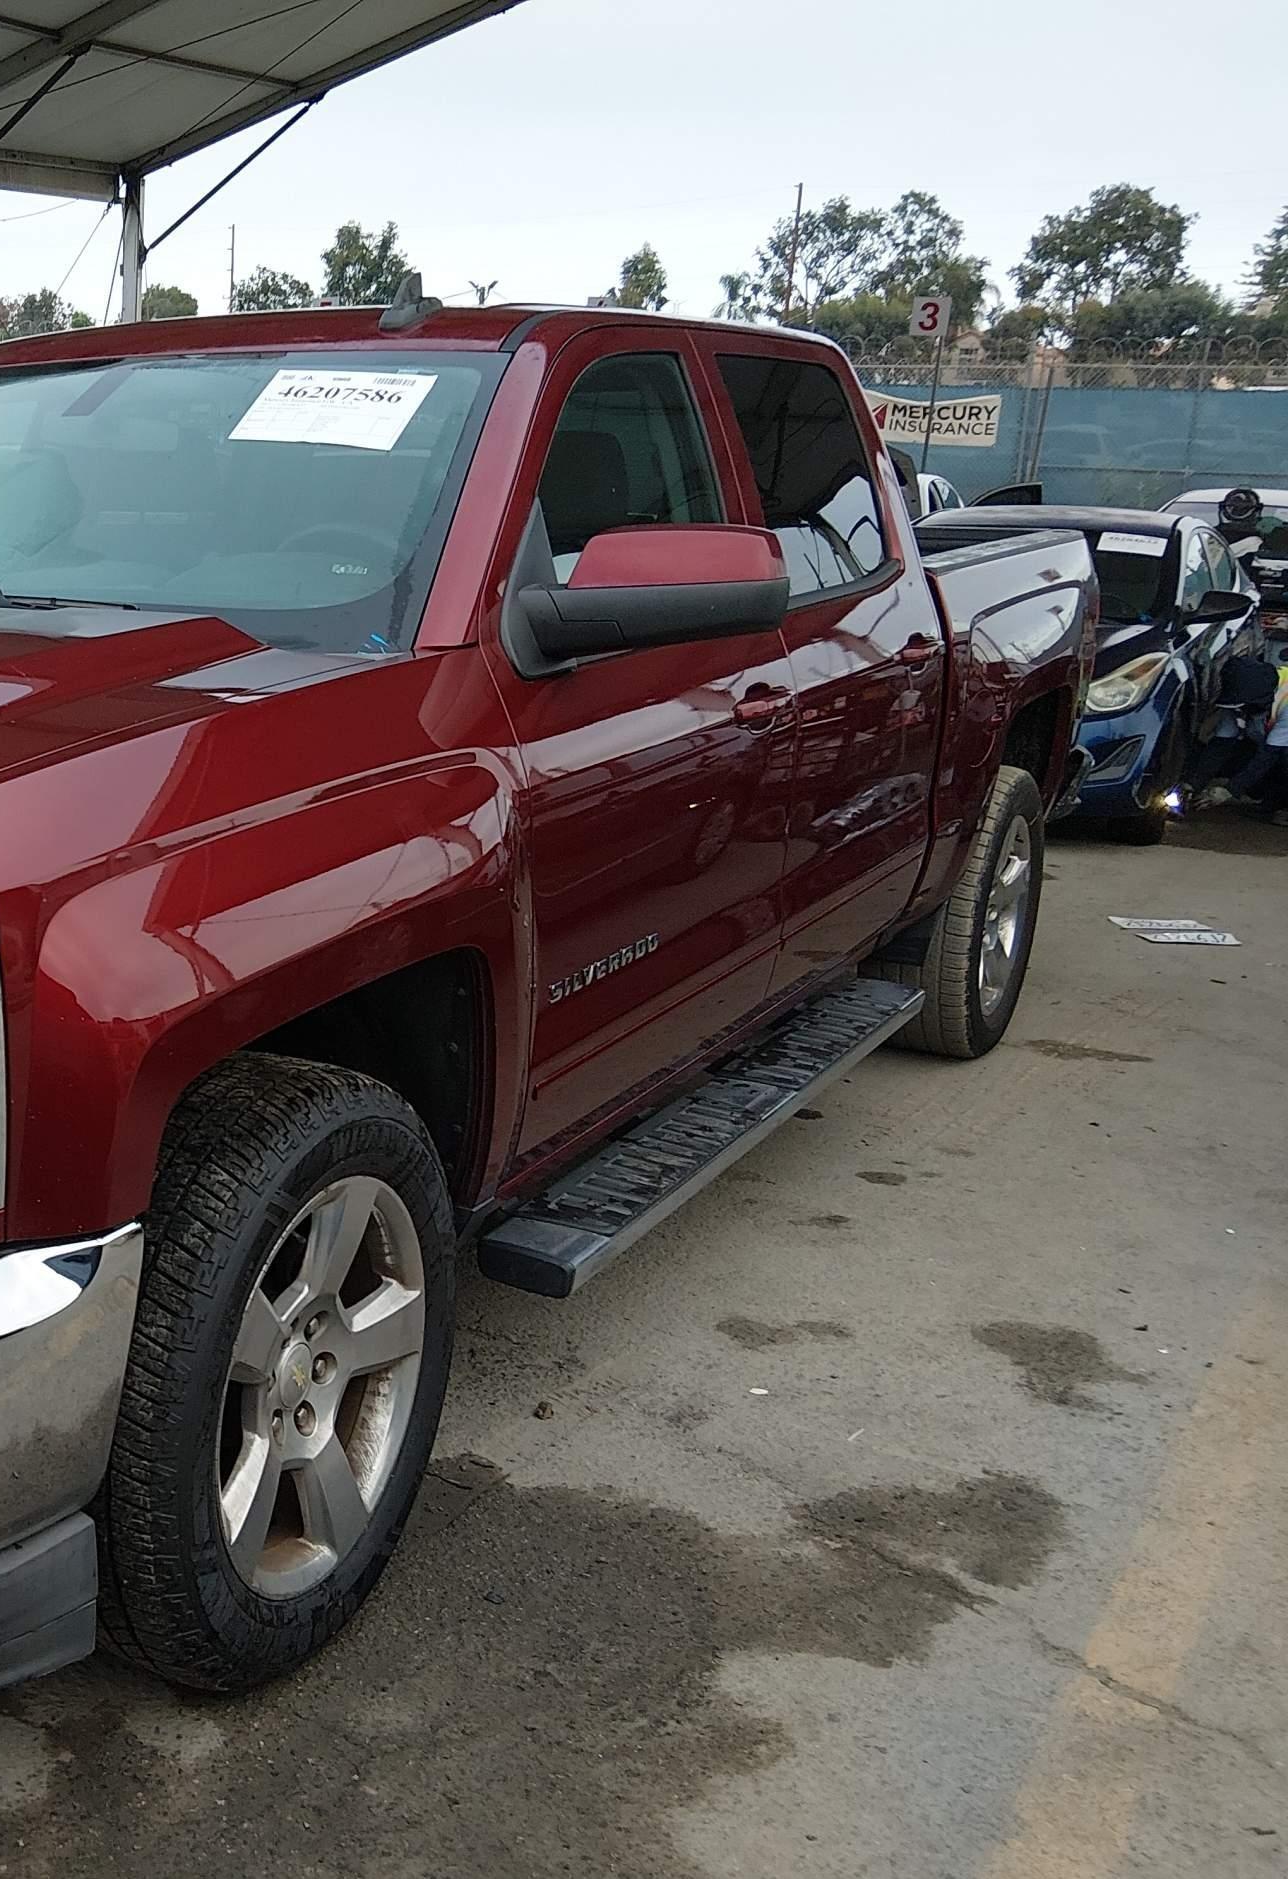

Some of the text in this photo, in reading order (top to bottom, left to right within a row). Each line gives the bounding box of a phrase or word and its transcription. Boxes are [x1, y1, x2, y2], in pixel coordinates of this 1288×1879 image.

[918, 302, 940, 331] 3
[278, 385, 405, 404] 46207586
[891, 403, 998, 420] MERCURY
[889, 419, 996, 436] INSURANCE
[550, 933, 659, 1003] SILVERADO
